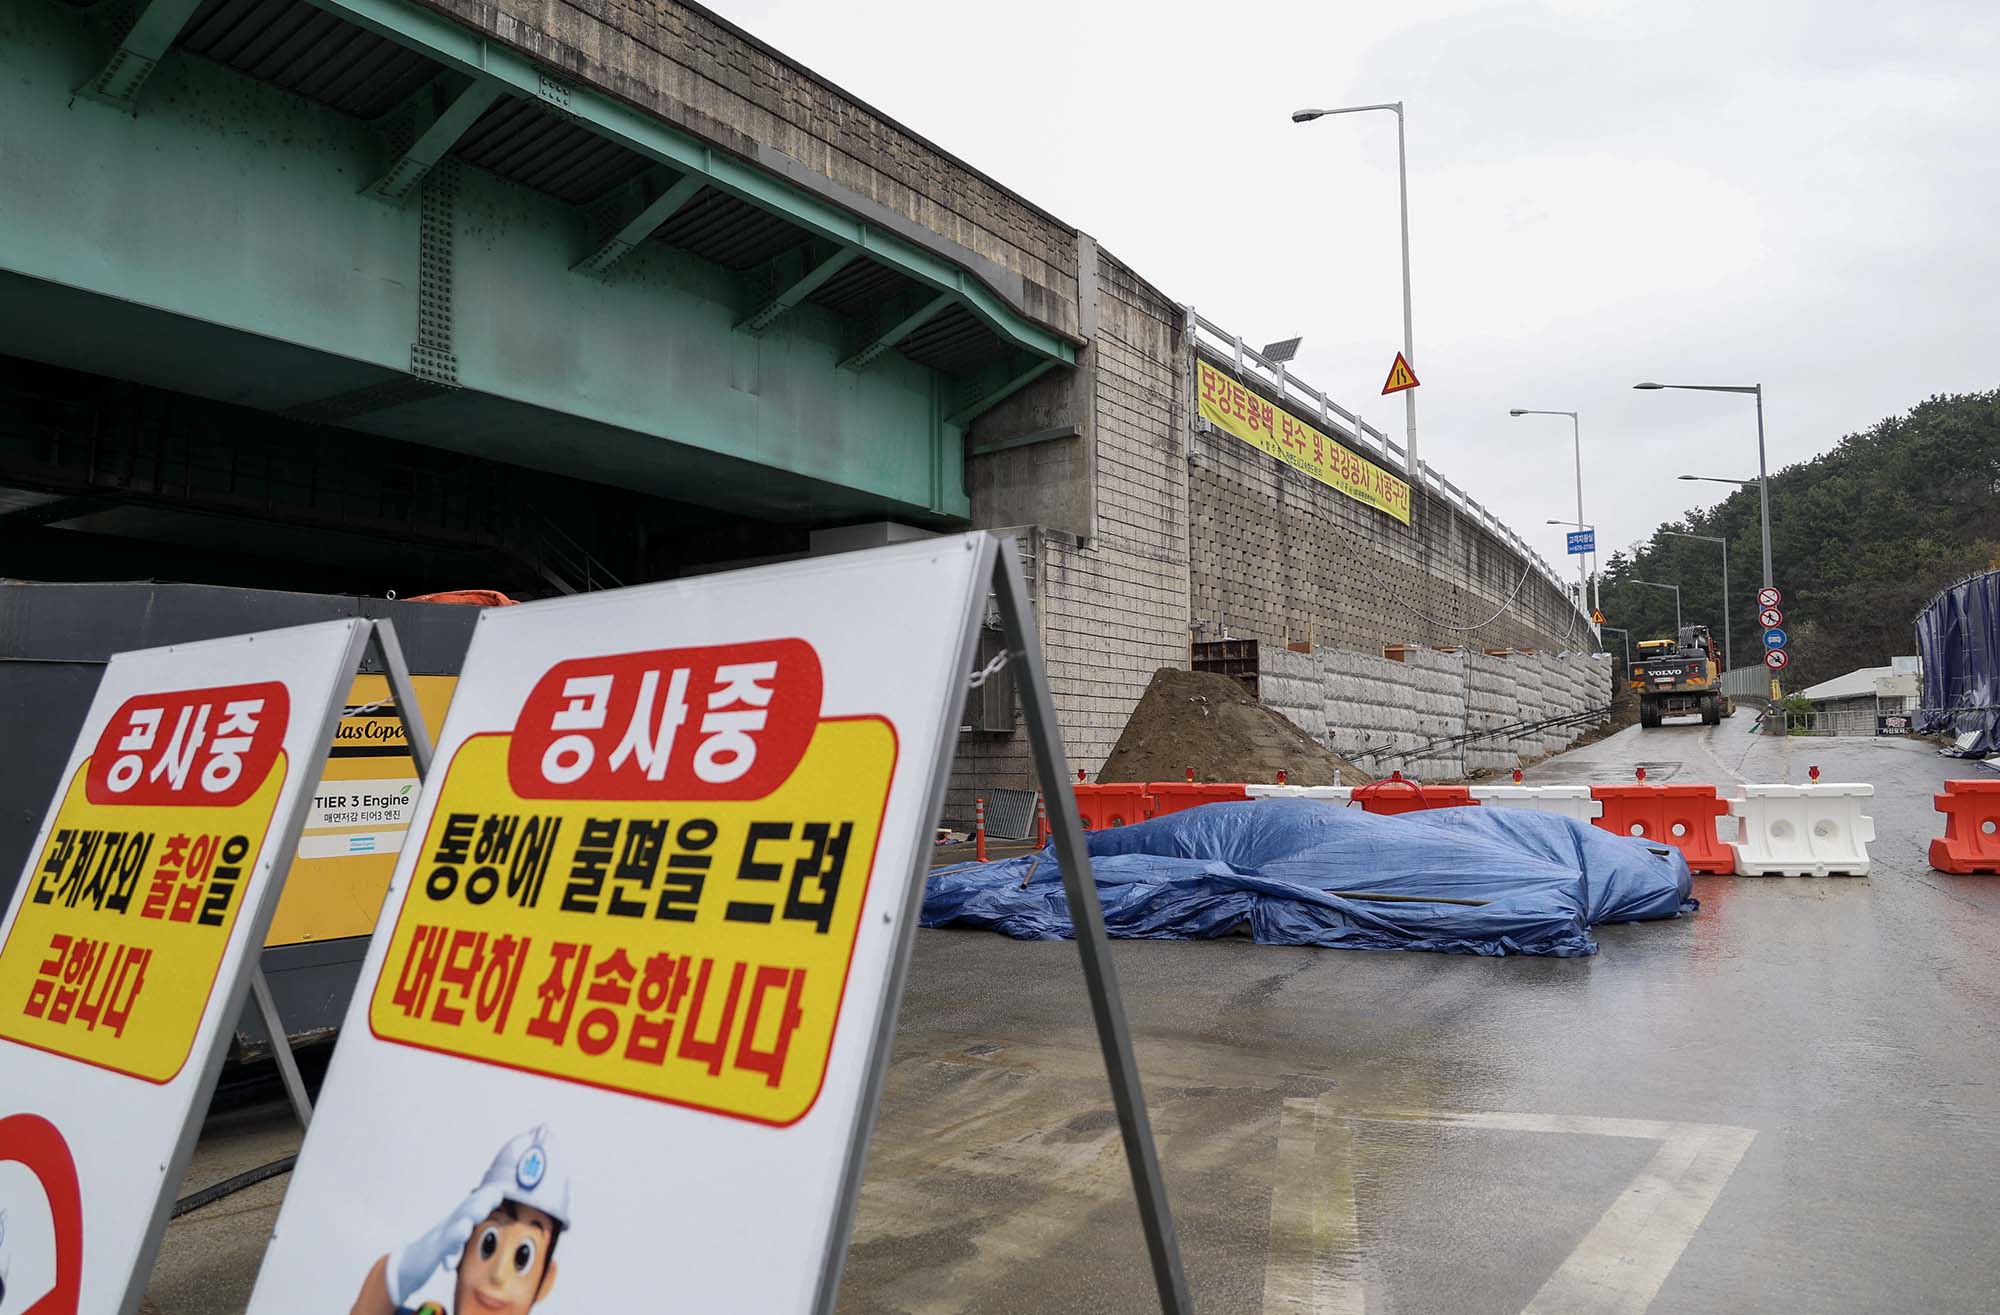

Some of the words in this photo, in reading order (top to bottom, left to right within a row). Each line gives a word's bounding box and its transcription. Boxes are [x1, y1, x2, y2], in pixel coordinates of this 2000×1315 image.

[1201, 366, 1274, 434] 보강토옹벽
[1282, 414, 1307, 455] 보수
[1313, 433, 1324, 466] 및
[1330, 443, 1370, 491] 보강공사
[1375, 470, 1409, 512] 시공구간
[540, 660, 778, 784] 공사중
[1648, 669, 1682, 677] VOLVO
[106, 698, 265, 793] 공사중
[314, 796, 346, 808] TIER
[351, 796, 359, 807] 3
[364, 794, 409, 808] Engine
[361, 810, 382, 821] 티어3
[384, 810, 400, 820] 엔진
[33, 829, 155, 915] 관계자외
[140, 833, 249, 926] 출입을
[426, 813, 562, 908] 통행에
[560, 817, 718, 923] 불편을
[724, 821, 854, 935] 드려
[24, 934, 152, 1038] 금합니다
[393, 925, 531, 1034] 대단히
[527, 942, 807, 1088] 죄송합니다
